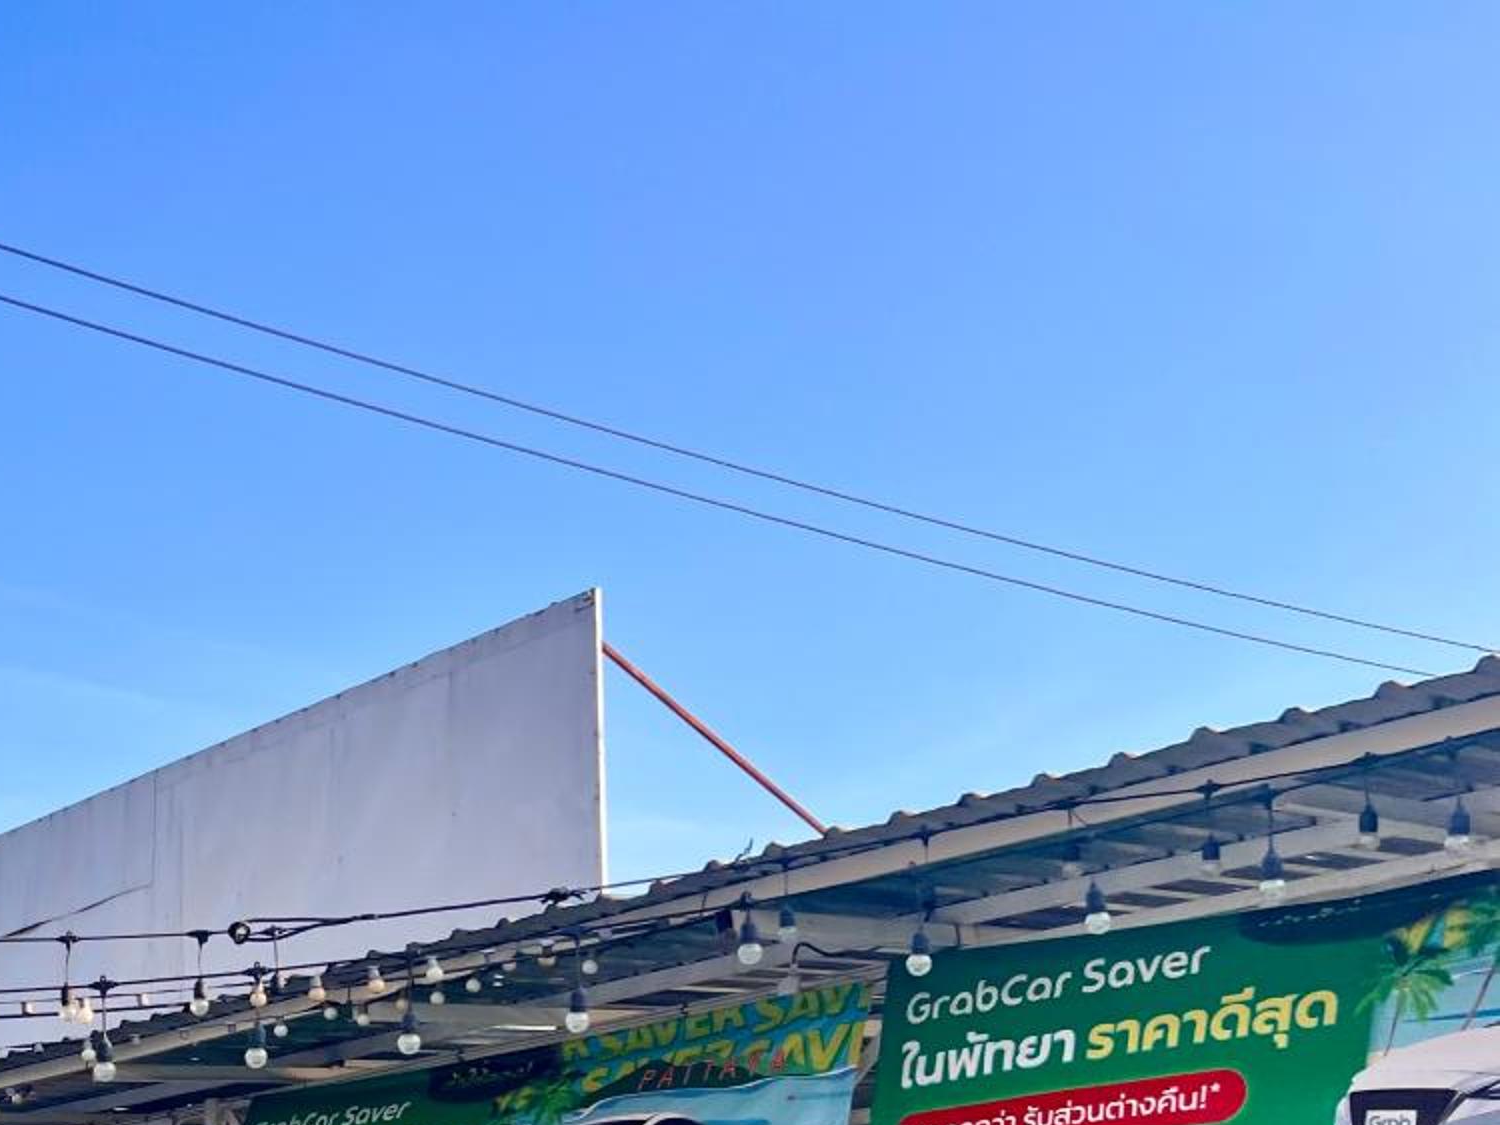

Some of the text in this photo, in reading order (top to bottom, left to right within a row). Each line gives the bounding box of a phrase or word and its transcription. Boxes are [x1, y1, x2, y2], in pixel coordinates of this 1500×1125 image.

[906, 945, 1212, 1025] GrabCar Saver
[638, 1046, 787, 1090] PATTAYA
[901, 984, 1339, 1089] ในพัทยา ราคาดีสุด
